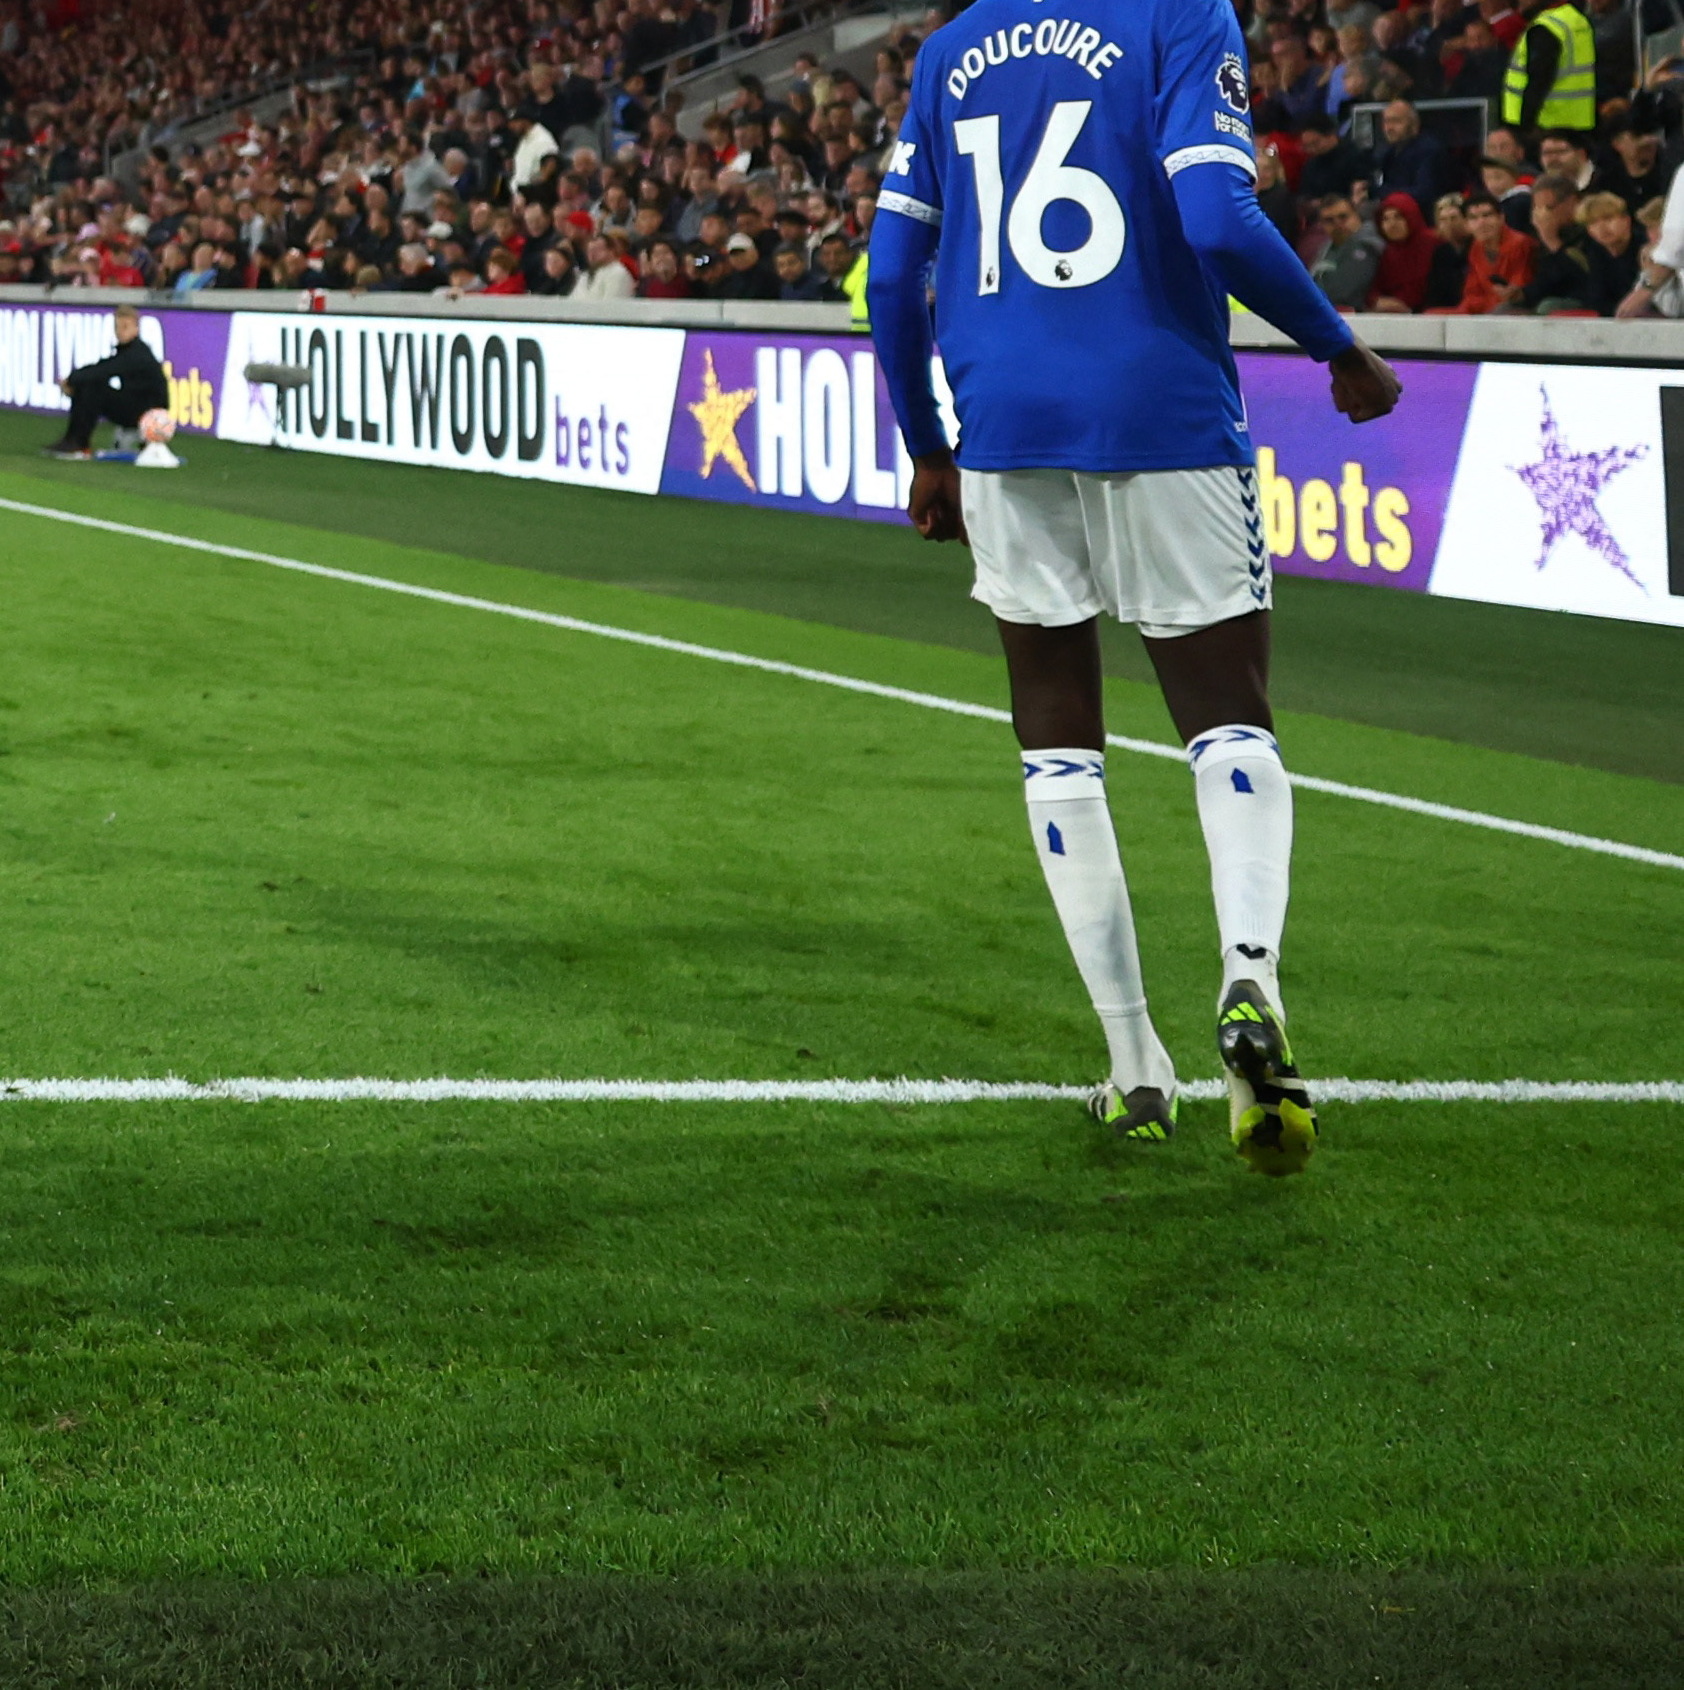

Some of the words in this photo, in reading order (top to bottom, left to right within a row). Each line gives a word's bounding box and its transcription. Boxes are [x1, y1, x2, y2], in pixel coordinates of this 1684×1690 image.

[947, 19, 1123, 101] DOUCOURE
[953, 100, 1126, 297] 16
[281, 326, 545, 462] HOLLYWOOD
[554, 395, 630, 476] bets
[1256, 446, 1413, 572] bets
